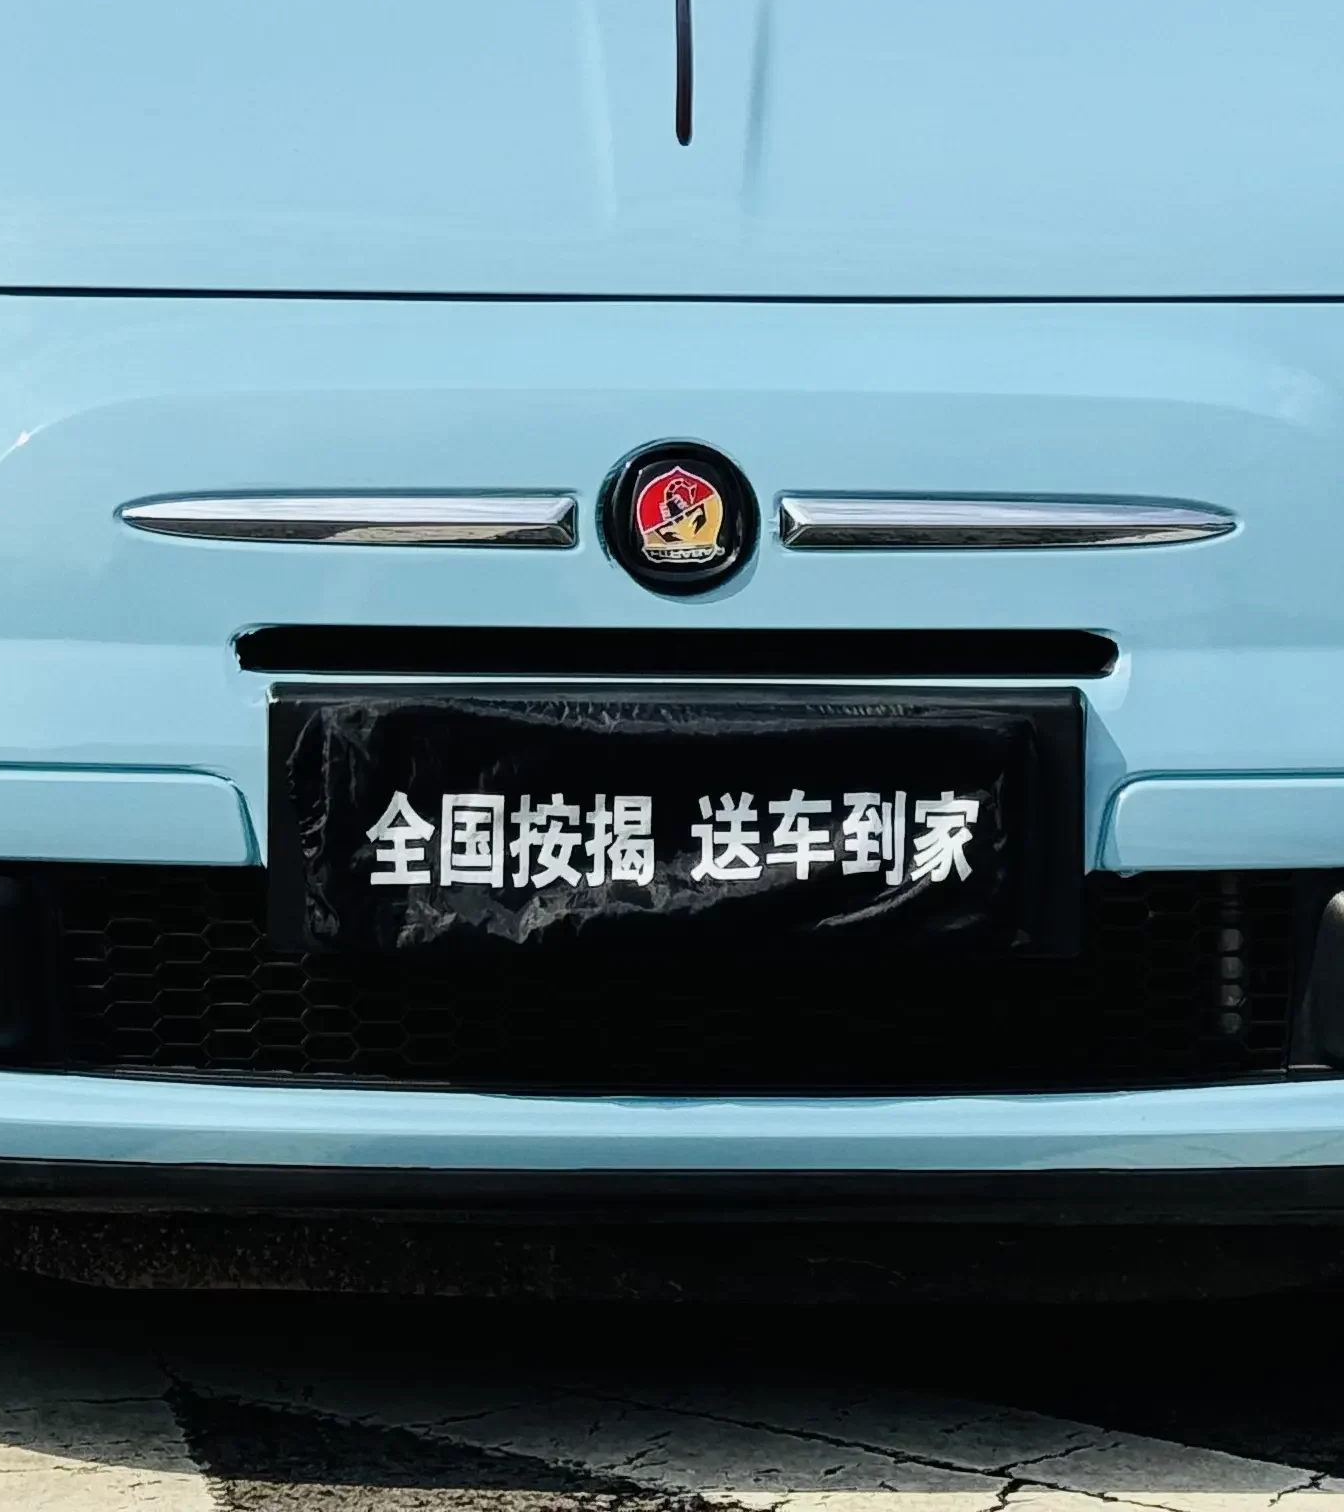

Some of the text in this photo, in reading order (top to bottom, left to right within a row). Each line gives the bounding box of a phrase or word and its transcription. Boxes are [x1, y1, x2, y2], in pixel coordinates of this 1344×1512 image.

[367, 789, 981, 889] 全国按揭 送车到家
